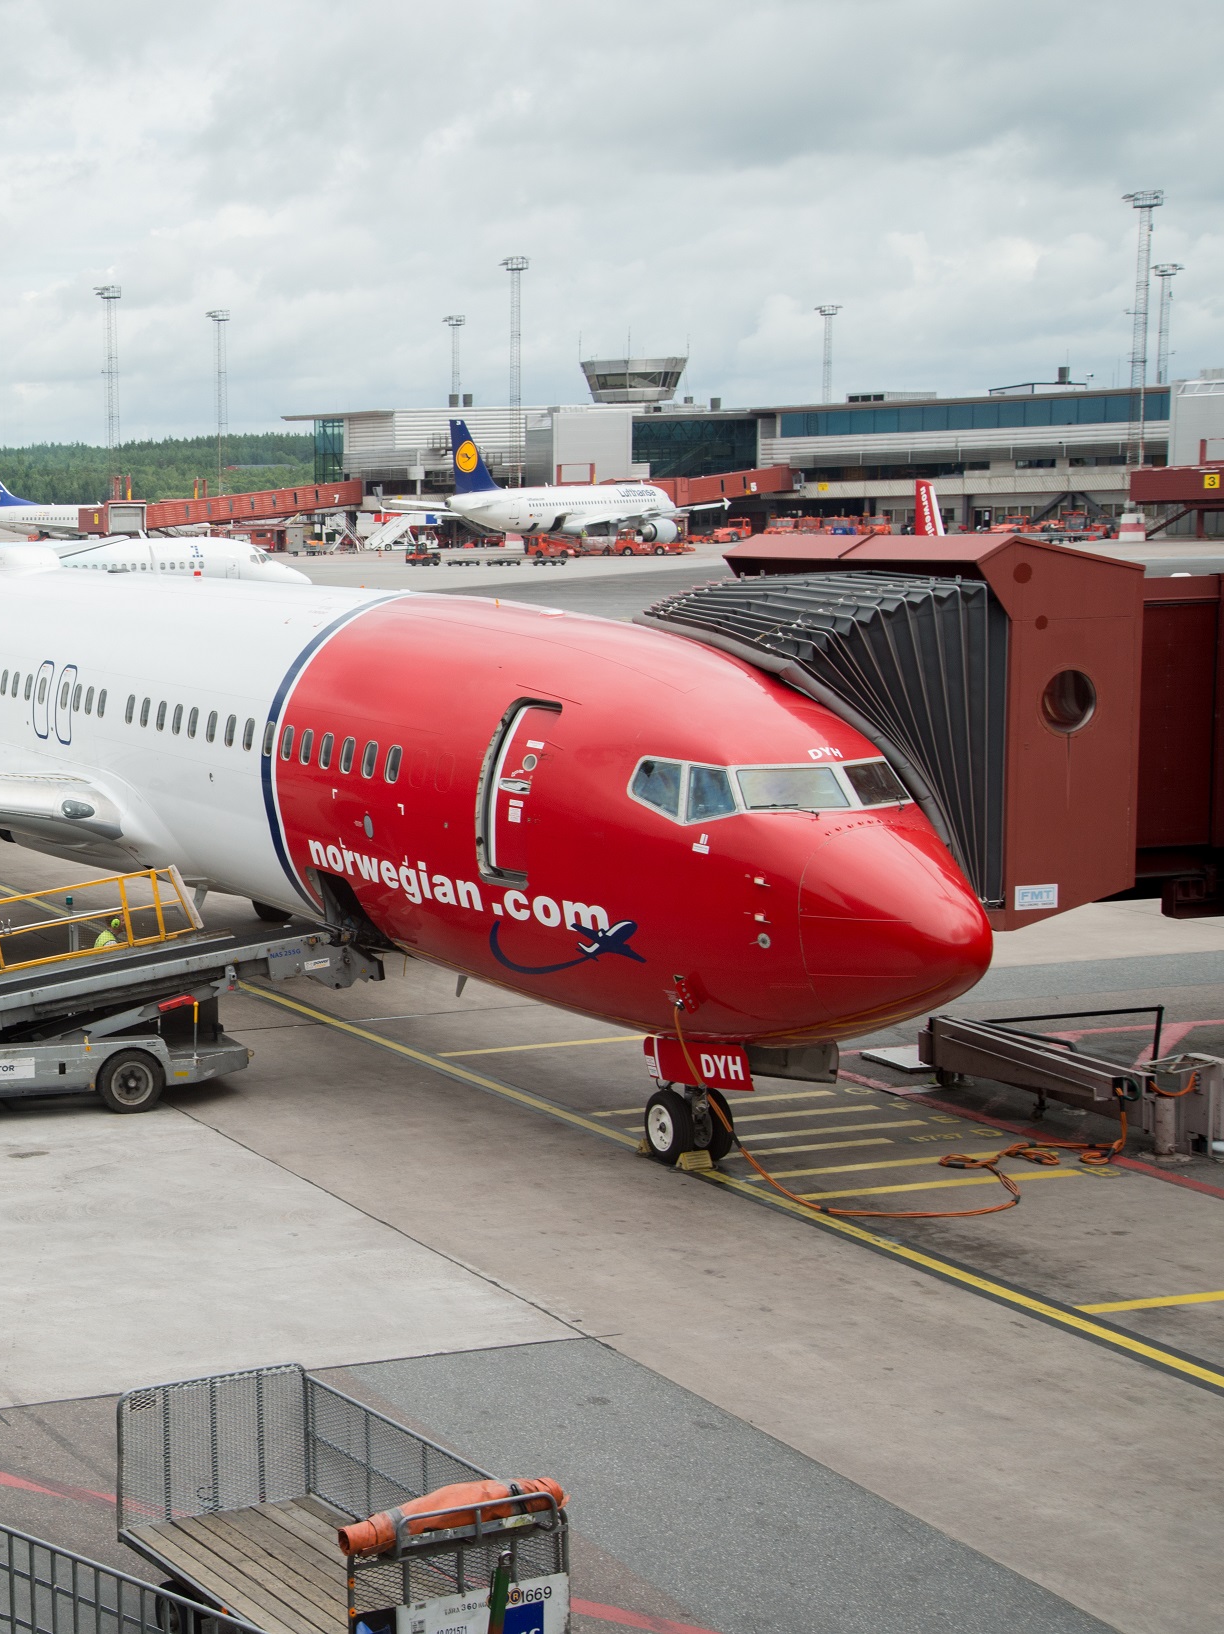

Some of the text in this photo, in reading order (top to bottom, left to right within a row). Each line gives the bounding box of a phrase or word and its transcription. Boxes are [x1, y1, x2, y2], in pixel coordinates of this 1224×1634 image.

[750, 482, 757, 492] 5
[1208, 476, 1216, 487] 3
[616, 488, 656, 498] Lufthansa
[333, 494, 340, 504] 7
[807, 746, 844, 760] DYH
[308, 838, 610, 931] norwegian .com
[1021, 890, 1052, 901] FMT
[700, 1053, 745, 1081] DYH
[461, 1602, 478, 1611] 360
